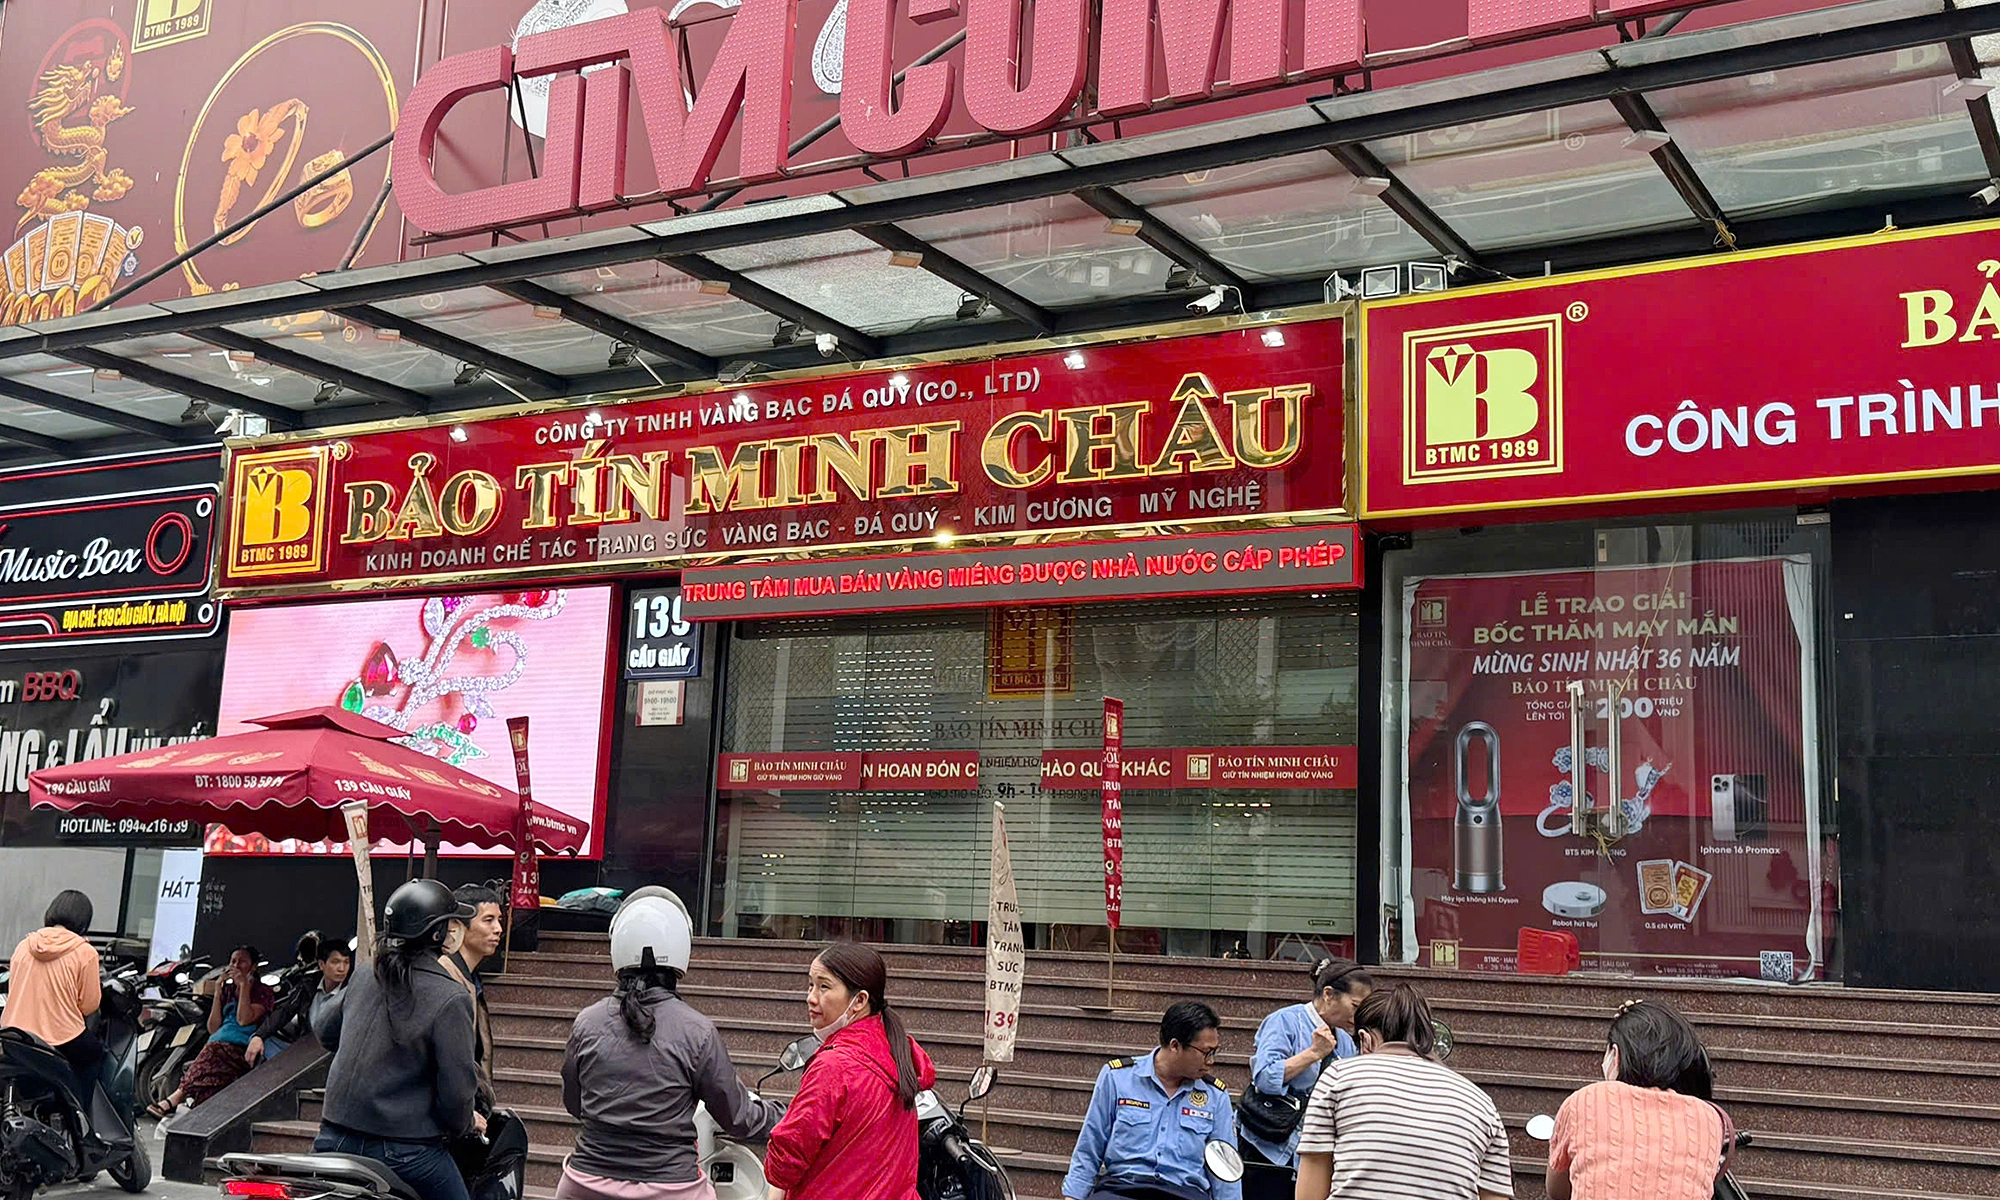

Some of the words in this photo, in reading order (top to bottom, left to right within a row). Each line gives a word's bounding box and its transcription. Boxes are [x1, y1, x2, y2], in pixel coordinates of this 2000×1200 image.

[143, 21, 172, 39] BTMC
[175, 14, 200, 31] 1989
[1900, 259, 2000, 349] BẢ
[535, 419, 595, 446] CÔNG
[605, 418, 627, 437] TY
[635, 409, 693, 431] TNHH
[699, 402, 759, 426] VÀNG
[765, 395, 812, 421] BẠC
[822, 388, 853, 412] ĐÁ
[984, 367, 1041, 395] LTD)
[1625, 400, 1797, 456] CÔNG
[1816, 379, 2000, 440] TRÌNH
[340, 452, 503, 544] BẢO
[516, 440, 668, 530] TÍN
[684, 420, 962, 515] MINH
[980, 372, 1313, 490] CHÂU
[1425, 445, 1481, 465] BTMC
[1488, 439, 1540, 460] 1989
[366, 552, 412, 571] KINH
[420, 545, 486, 567] DOANH
[493, 536, 531, 563] CHẾ
[539, 536, 577, 559] TÁC
[585, 533, 656, 556] TRANG
[664, 527, 708, 550] SỨC
[722, 522, 778, 545] VÀNG
[786, 518, 831, 544] BẠC
[855, 513, 884, 536] ĐÁ
[891, 507, 940, 534] QUÝ
[974, 504, 1016, 527] KIM
[1026, 496, 1113, 522] CƯƠNG
[1139, 489, 1177, 514] MỸ
[1189, 480, 1262, 512] NGHỆ
[0, 546, 79, 584] Music
[78, 536, 143, 580] Box
[241, 547, 275, 563] BTMC
[278, 543, 308, 560] 1989
[683, 581, 746, 602] TRUNG
[750, 575, 789, 598] TÂM
[793, 575, 836, 596] MUA
[839, 569, 880, 595] BÁN
[885, 567, 943, 590] VÀNG
[948, 561, 1014, 587] MIẾNG
[1018, 559, 1087, 585] ĐƯỢC
[1091, 552, 1140, 579] NHÀ
[1145, 548, 1217, 576] NƯỚC
[1222, 545, 1273, 571] CẤP
[1278, 540, 1347, 568] PHÉP
[1521, 591, 1548, 616] LỄ
[1556, 594, 1625, 614] TRAO
[1633, 587, 1686, 611] GIẢI
[62, 609, 79, 632] ĐỊA
[96, 606, 115, 627] 139
[155, 600, 169, 623] HÀ
[168, 599, 187, 626] NỘI
[633, 595, 691, 639] 139
[1474, 620, 1524, 644] BỐC
[1532, 619, 1604, 642] THĂM
[1612, 619, 1669, 638] MAY
[1677, 609, 1738, 636] MẮN
[658, 642, 691, 667] GIẤY
[1472, 649, 1533, 675] MỪNG
[1539, 650, 1590, 673] SINH
[1596, 645, 1654, 673] NHẬT
[1656, 647, 1681, 669] 36
[1689, 641, 1741, 667] NĂM
[22, 670, 83, 701] BBQ
[1512, 679, 1549, 694] BẢO
[1645, 673, 1697, 690] CHÂU
[1526, 700, 1554, 710] TỔNG
[1596, 697, 1653, 719] 200
[1657, 709, 1681, 717] VNĐ
[1013, 720, 1062, 738] MINH
[46, 738, 63, 769] &
[1218, 757, 1242, 767] BẢO
[1244, 755, 1265, 767] TÍN
[1268, 757, 1301, 766] MINH
[1303, 754, 1339, 766] CHÂU
[754, 760, 773, 771] BẢO
[774, 759, 792, 771] TÍN
[792, 762, 818, 771] MINH
[819, 759, 847, 770] CHÂU
[878, 763, 922, 777] HOAN
[926, 760, 960, 777] ĐÓN
[964, 763, 979, 777] C
[1080, 763, 1102, 777] QU
[1122, 760, 1171, 776] KHÁC
[66, 779, 87, 794] CẦU
[88, 776, 111, 793] GIẤY
[195, 775, 214, 788] ĐT:
[216, 775, 242, 788] 1800
[335, 779, 358, 793] 139
[359, 781, 385, 795] CẦU
[385, 786, 412, 801] GIẤY
[60, 817, 116, 833] HOTLINE:
[1580, 848, 1594, 857] KIM
[1700, 845, 1732, 854] Iphone
[1735, 844, 1743, 853] 16
[1745, 846, 1780, 854] Promax
[161, 876, 195, 898] HÁT
[521, 871, 537, 885] 13
[1552, 919, 1572, 927] Robot
[1645, 921, 1655, 929] 0.5
[997, 961, 1018, 973] SỨC
[985, 1009, 1015, 1029] 139
